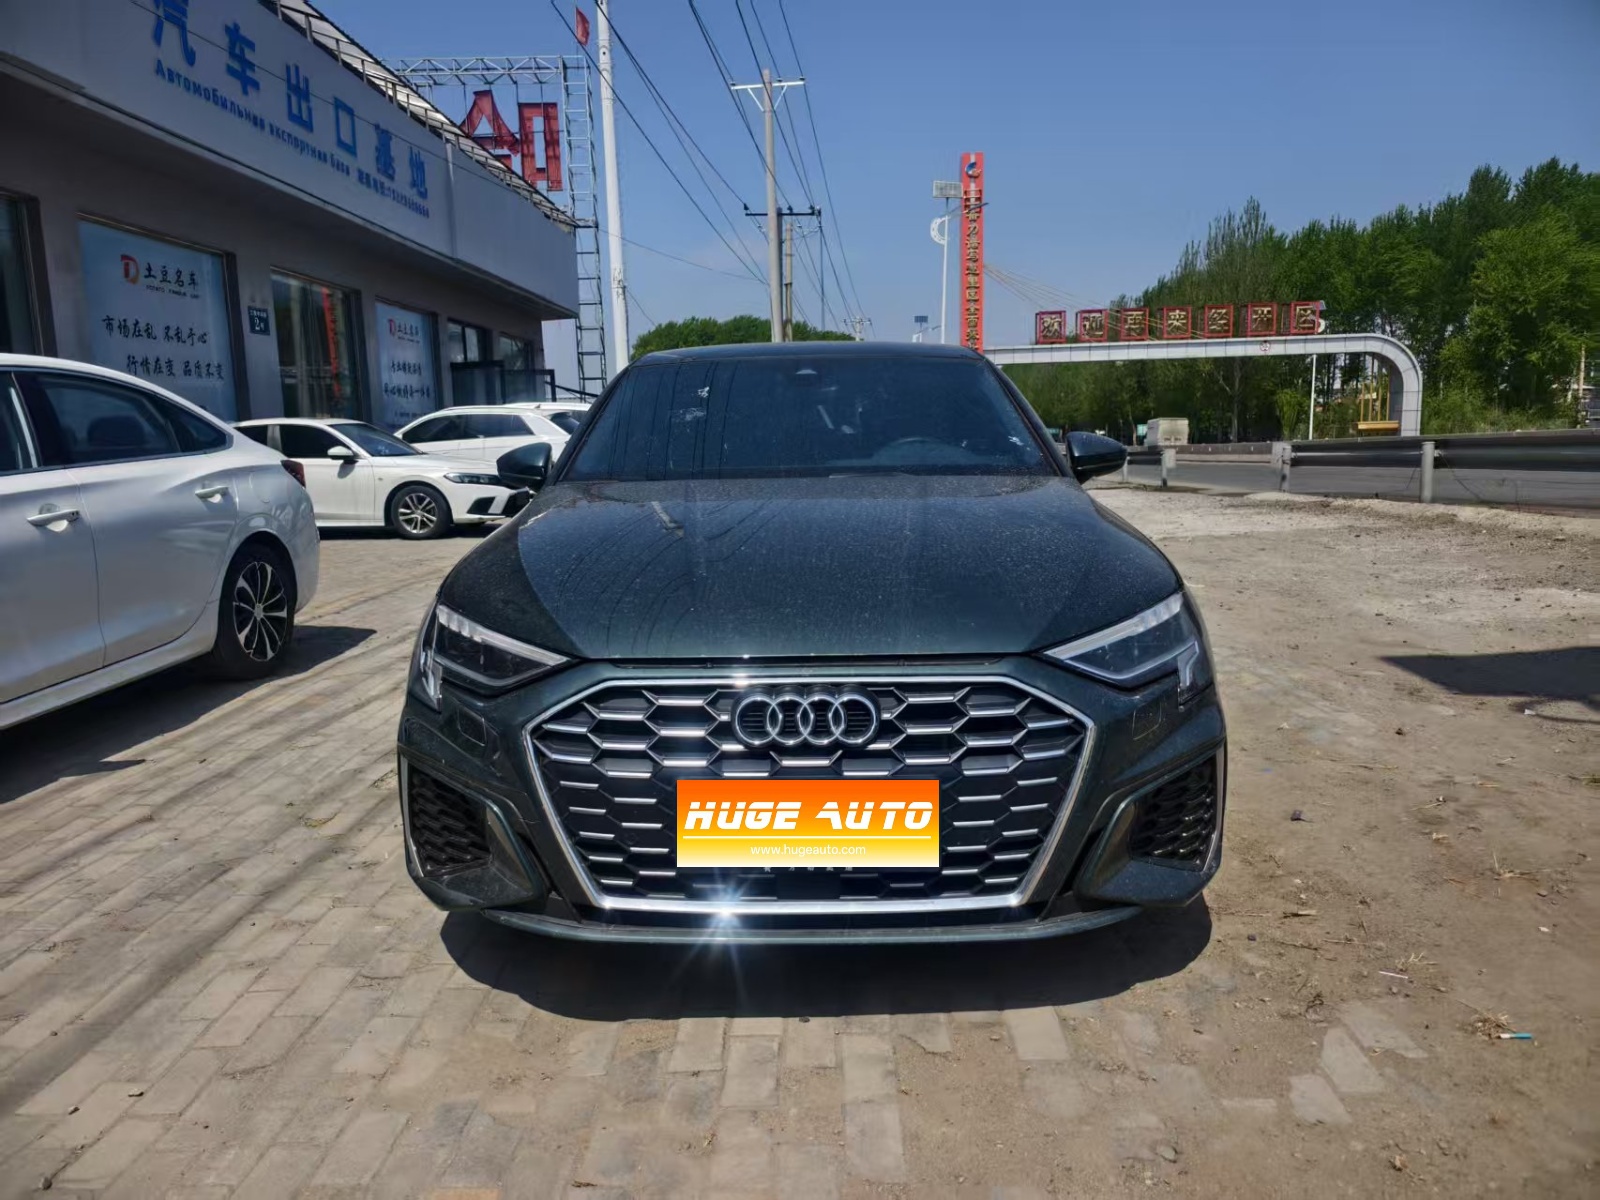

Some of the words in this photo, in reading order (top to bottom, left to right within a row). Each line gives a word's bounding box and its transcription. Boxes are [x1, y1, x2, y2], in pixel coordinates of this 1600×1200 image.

[153, 0, 428, 199] 汽车出口基地
[144, 262, 198, 290] 土豆名车
[102, 315, 157, 340] 市场在乱
[1040, 305, 1315, 338] 欢迎再来经开区
[126, 355, 176, 377] 行情在变
